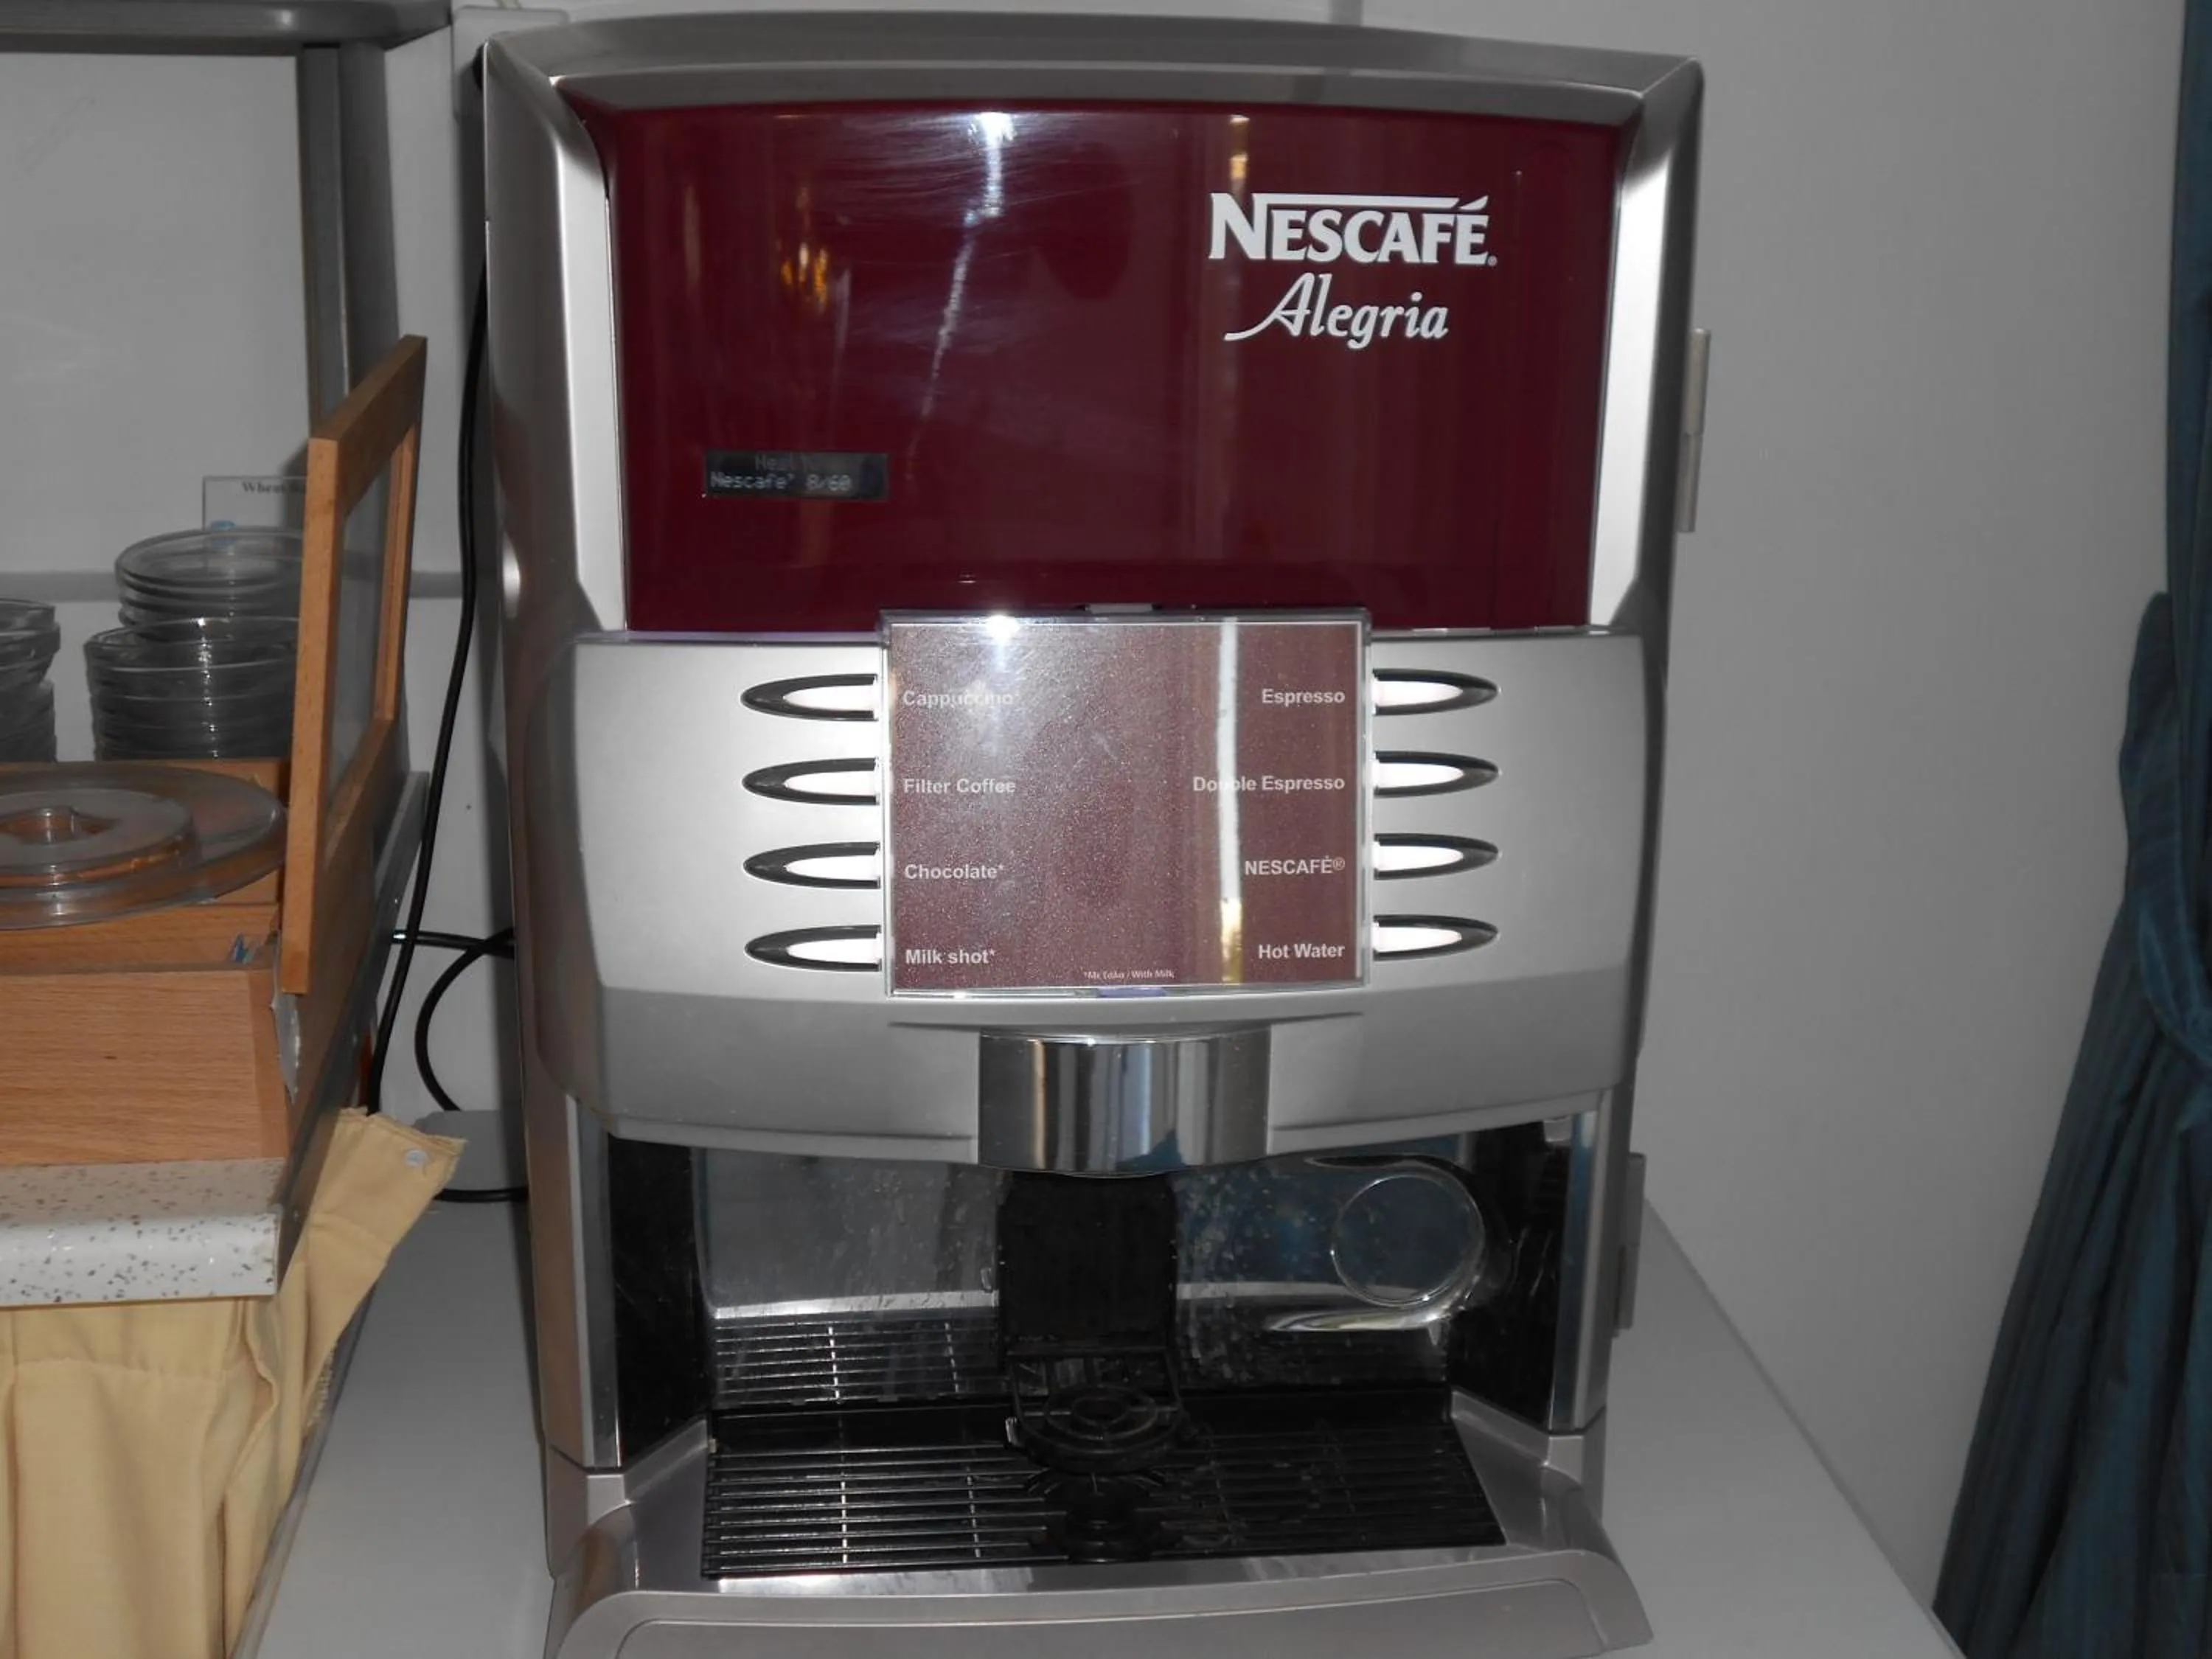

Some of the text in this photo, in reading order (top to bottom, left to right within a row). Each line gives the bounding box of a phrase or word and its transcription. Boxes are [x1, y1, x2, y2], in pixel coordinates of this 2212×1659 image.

[1224, 271, 1449, 349] Alegria
[1262, 689, 1345, 708] Espresso
[903, 778, 1016, 794] Filter Coffee
[1192, 776, 1345, 794] Doble Espresso
[905, 949, 944, 964] Milk
[1258, 943, 1346, 959] Hot Water
